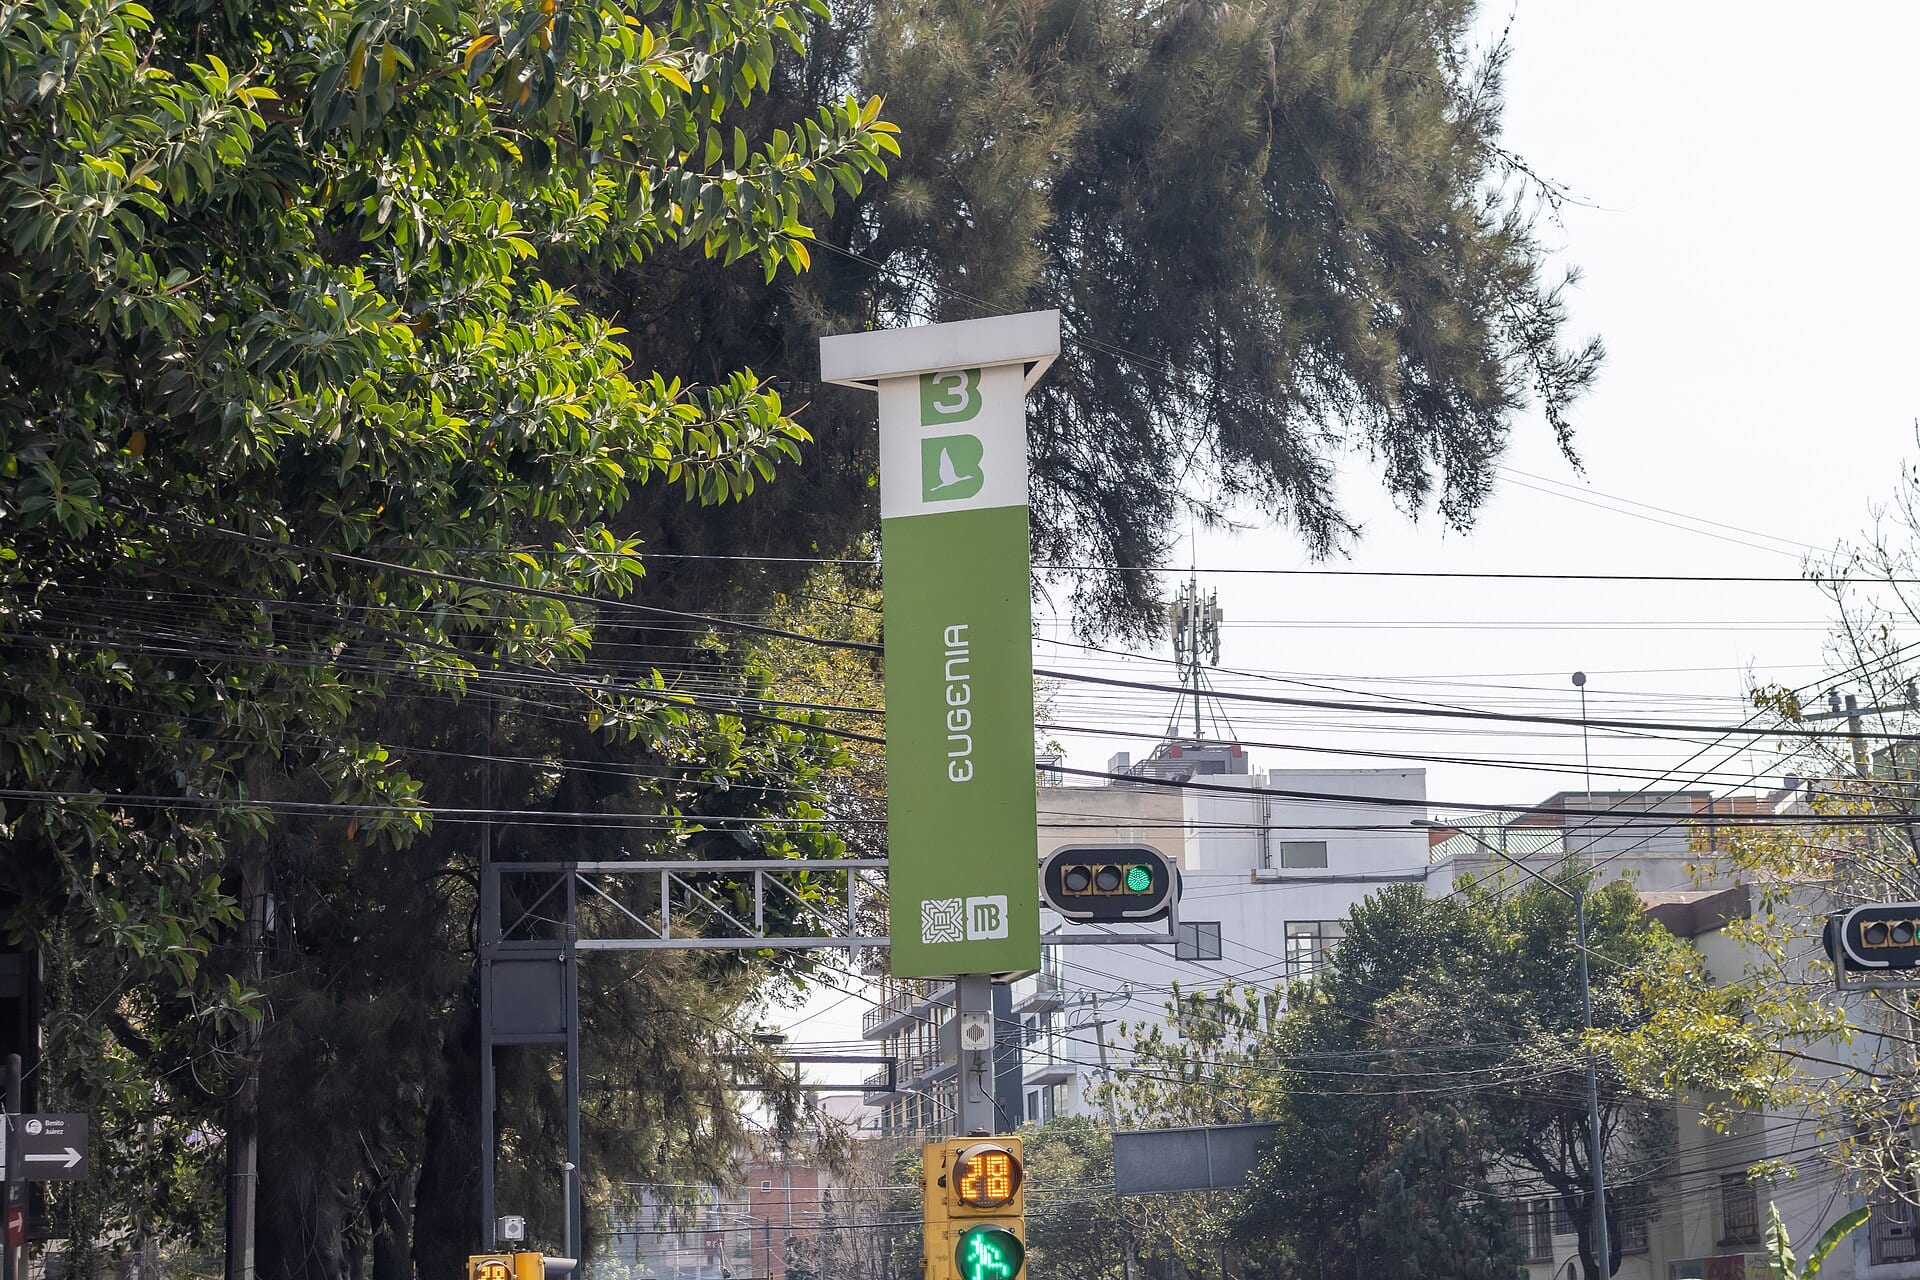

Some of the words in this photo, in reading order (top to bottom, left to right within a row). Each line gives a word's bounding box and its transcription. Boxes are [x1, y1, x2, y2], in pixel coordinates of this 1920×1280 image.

[932, 371, 969, 414] 3
[944, 624, 974, 783] EUGENIA
[973, 903, 1001, 933] MB
[45, 1119, 65, 1127] Benito
[961, 1155, 1009, 1198] 28
